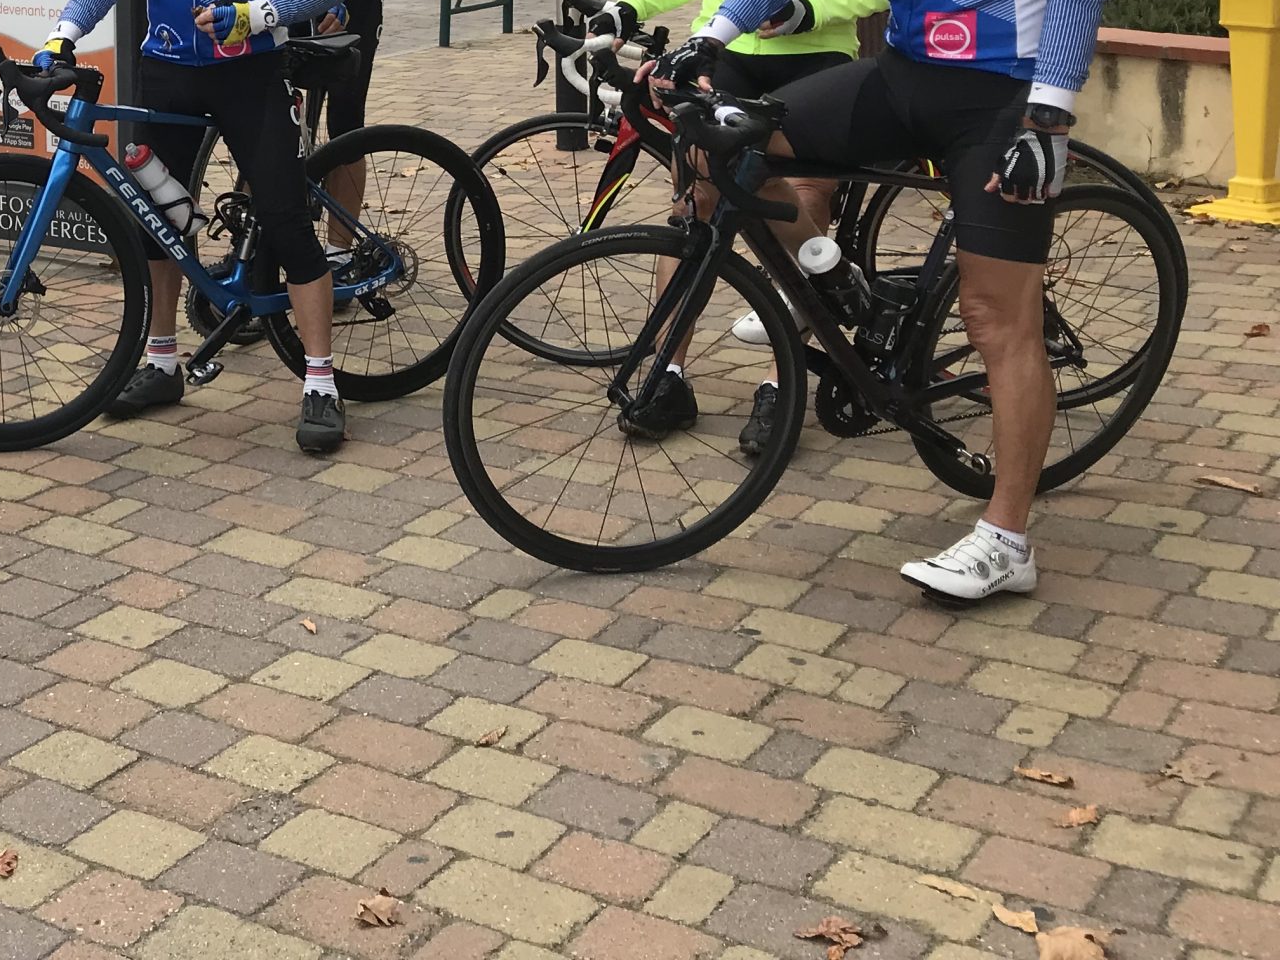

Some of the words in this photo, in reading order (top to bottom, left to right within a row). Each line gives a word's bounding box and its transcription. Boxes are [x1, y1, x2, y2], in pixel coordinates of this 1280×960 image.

[934, 33, 965, 42] pulsat
[18, 139, 32, 147] Store
[68, 211, 83, 222] AU
[105, 167, 188, 260] FERRUS
[354, 284, 369, 296] GX
[371, 276, 386, 289] 32
[981, 569, 1015, 594] S-WORKS
